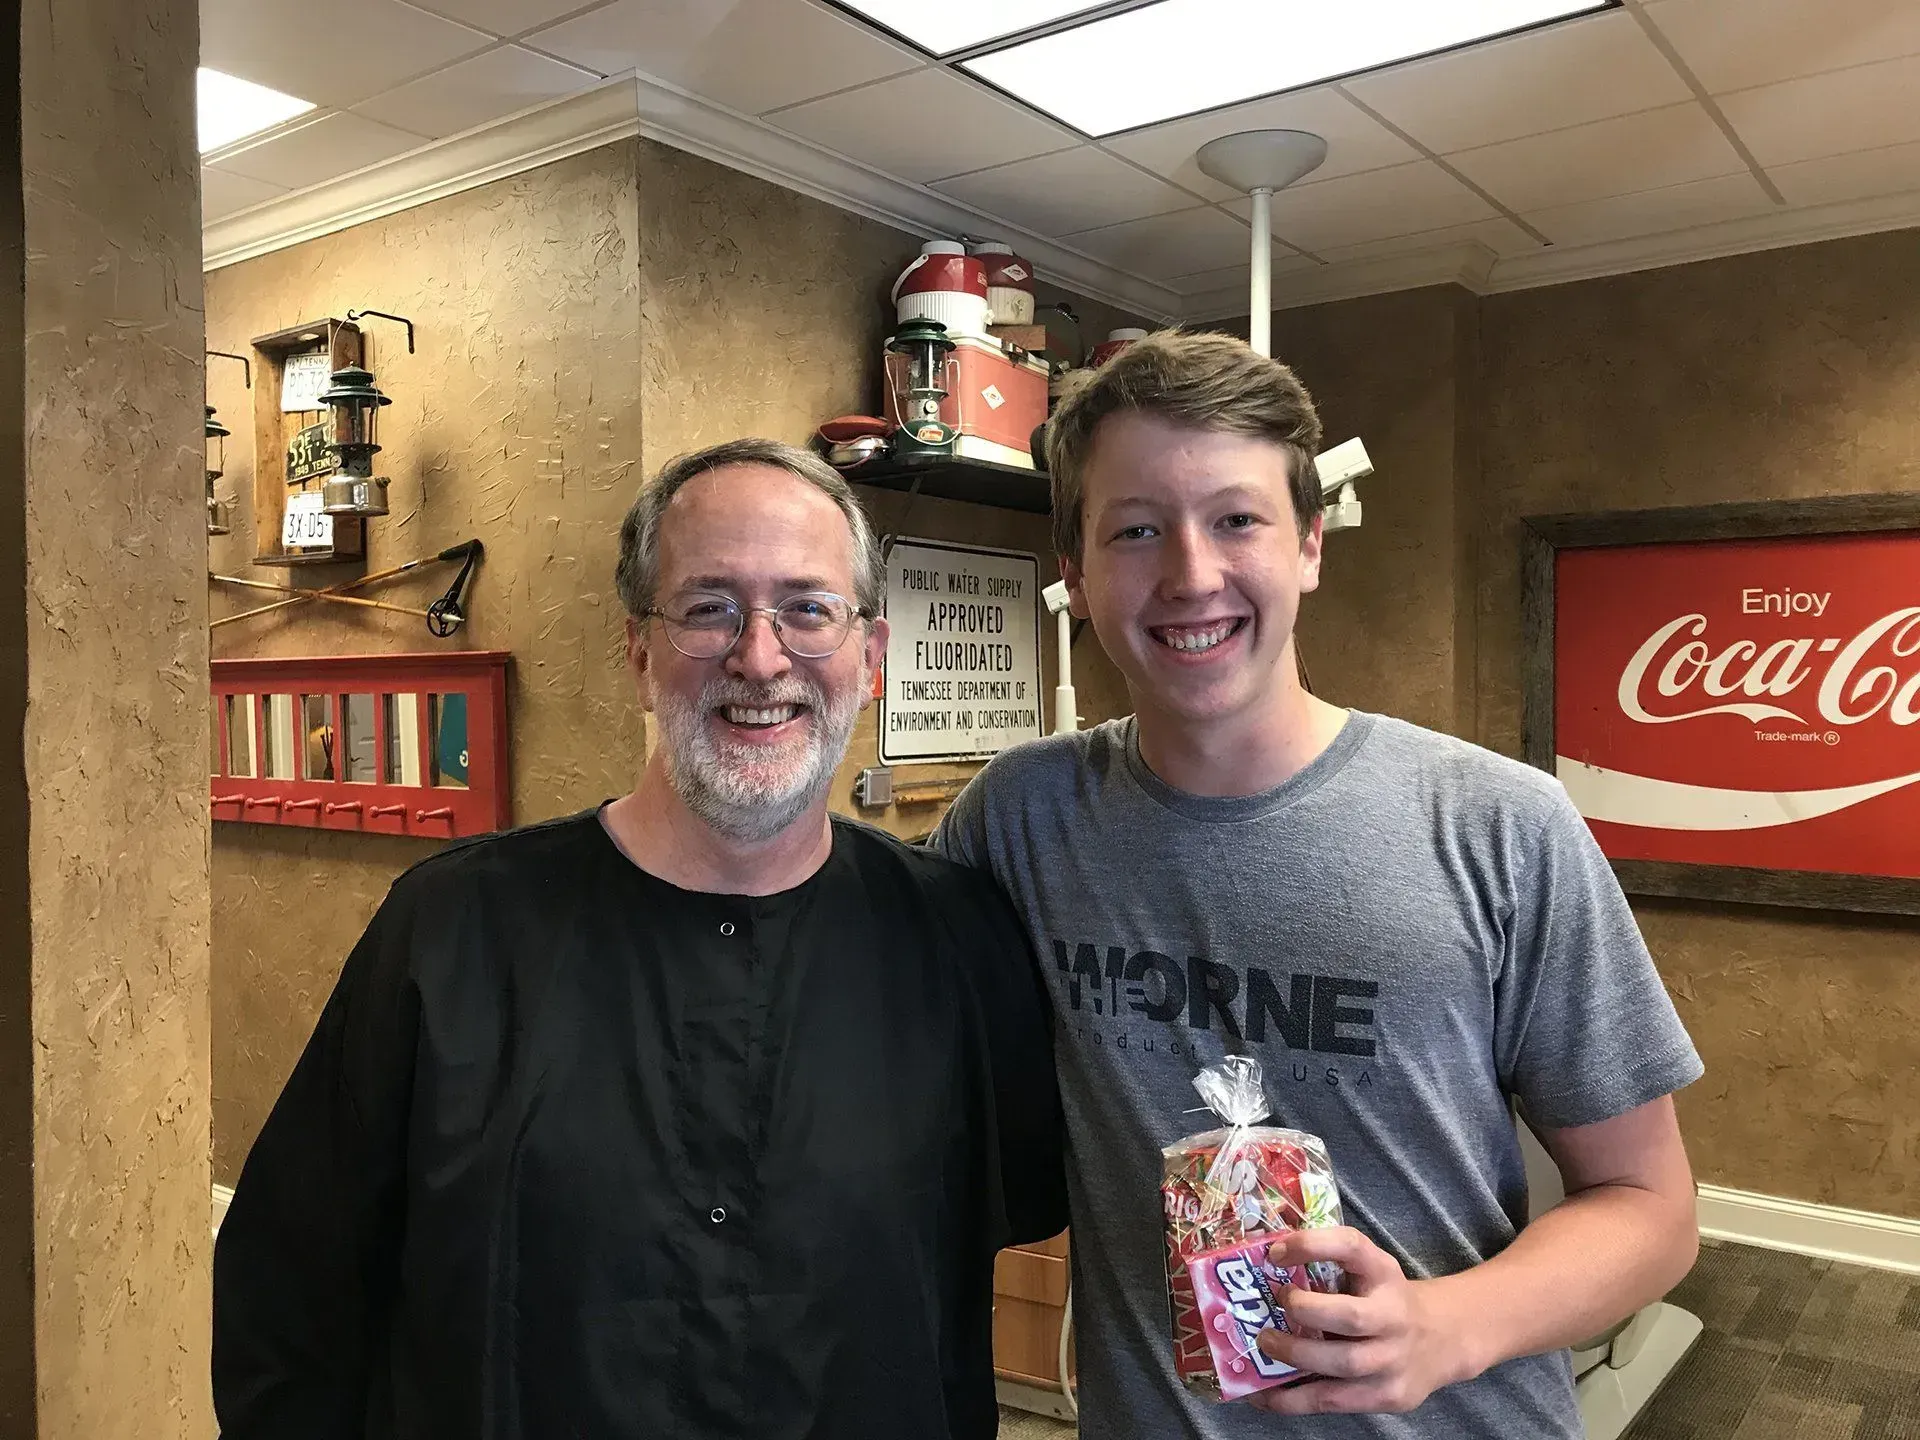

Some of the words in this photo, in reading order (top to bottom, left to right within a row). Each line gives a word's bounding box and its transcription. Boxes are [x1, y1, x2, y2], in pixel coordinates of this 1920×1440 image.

[903, 568, 940, 592] PUBLIC
[948, 571, 980, 596] WATER
[987, 577, 1022, 599] SUPPLY
[927, 602, 1004, 634] APPROVED
[1742, 587, 1832, 618] Enjoy
[916, 640, 1013, 672] FLUORIDATED
[901, 680, 952, 701] TENNESSEE
[958, 681, 1012, 701] DEPARTMENT
[1016, 681, 1027, 700] OF
[890, 710, 952, 732] ENVIRONMENT
[956, 711, 973, 730] AND
[978, 709, 1036, 730] CONSERVATION
